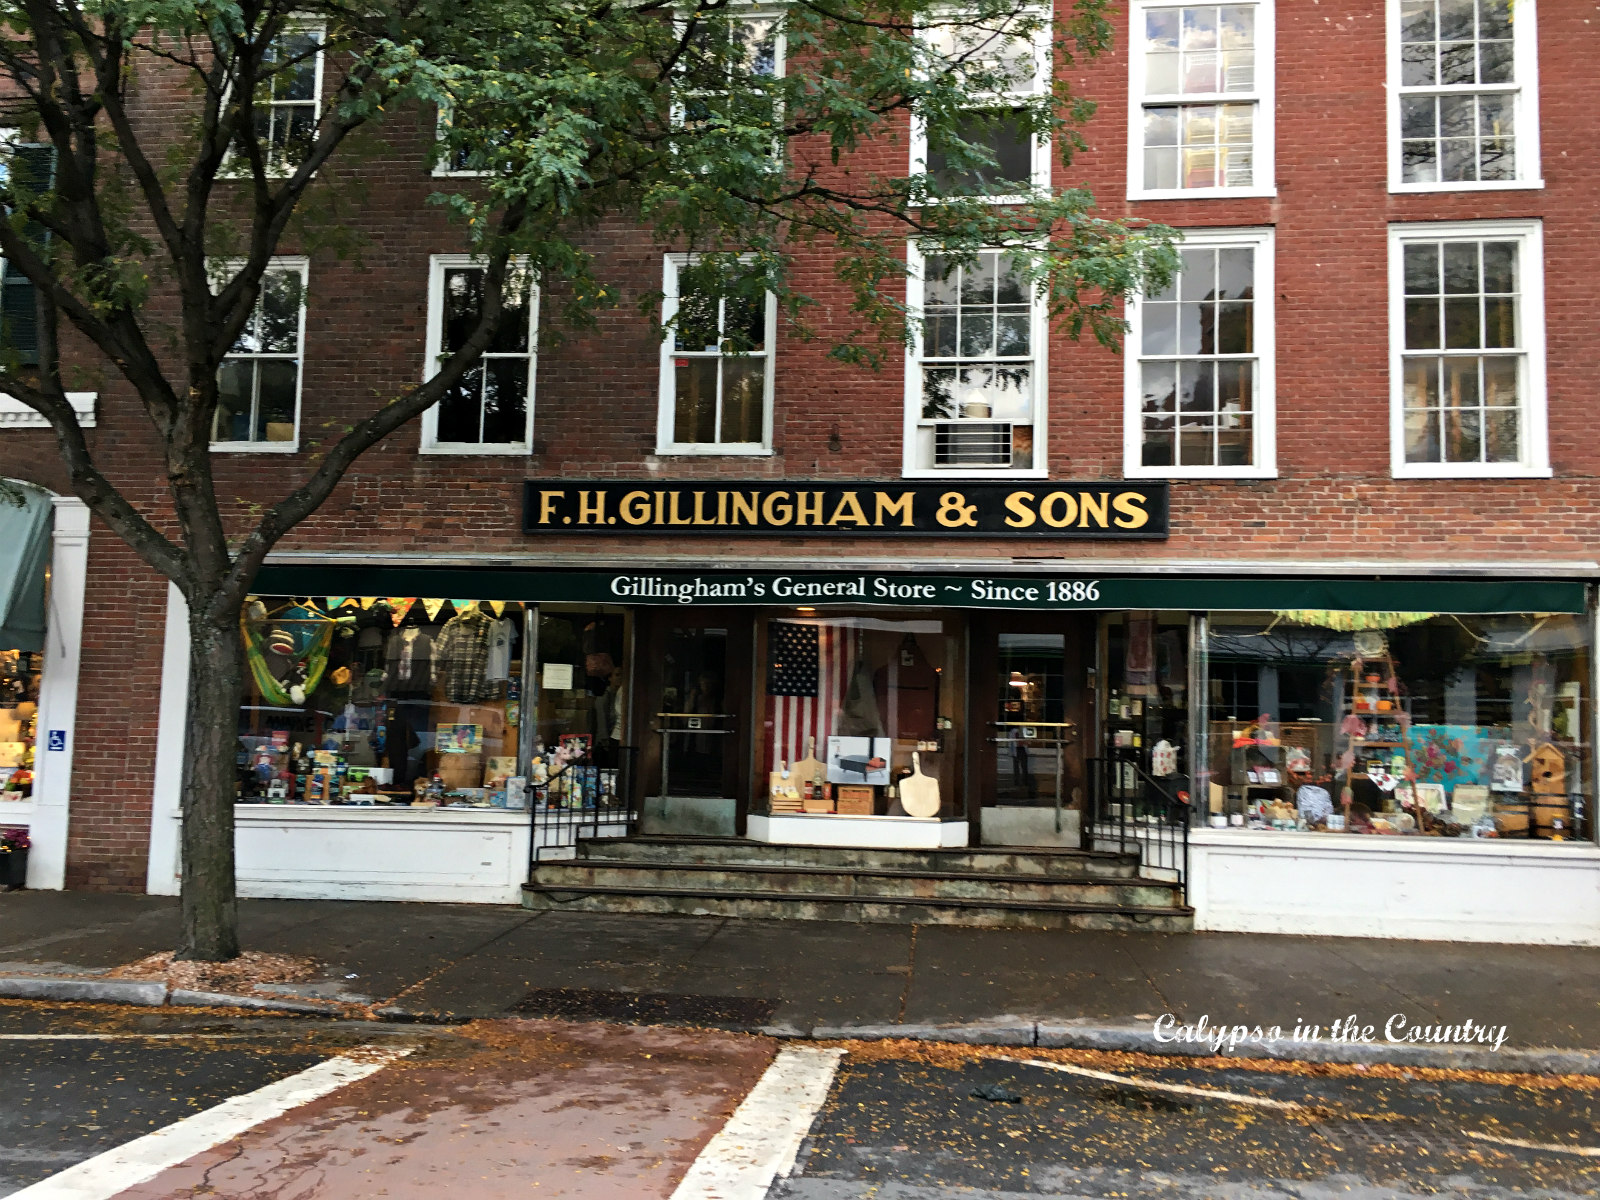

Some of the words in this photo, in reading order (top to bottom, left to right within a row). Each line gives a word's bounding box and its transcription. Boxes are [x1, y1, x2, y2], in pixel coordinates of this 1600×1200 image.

[935, 491, 979, 528] &
[1003, 491, 1149, 529] SONS
[610, 576, 766, 604] Gillingham's
[771, 577, 867, 597] General
[873, 577, 937, 598] Store
[971, 579, 1040, 601] Since
[1046, 580, 1100, 602] 1886
